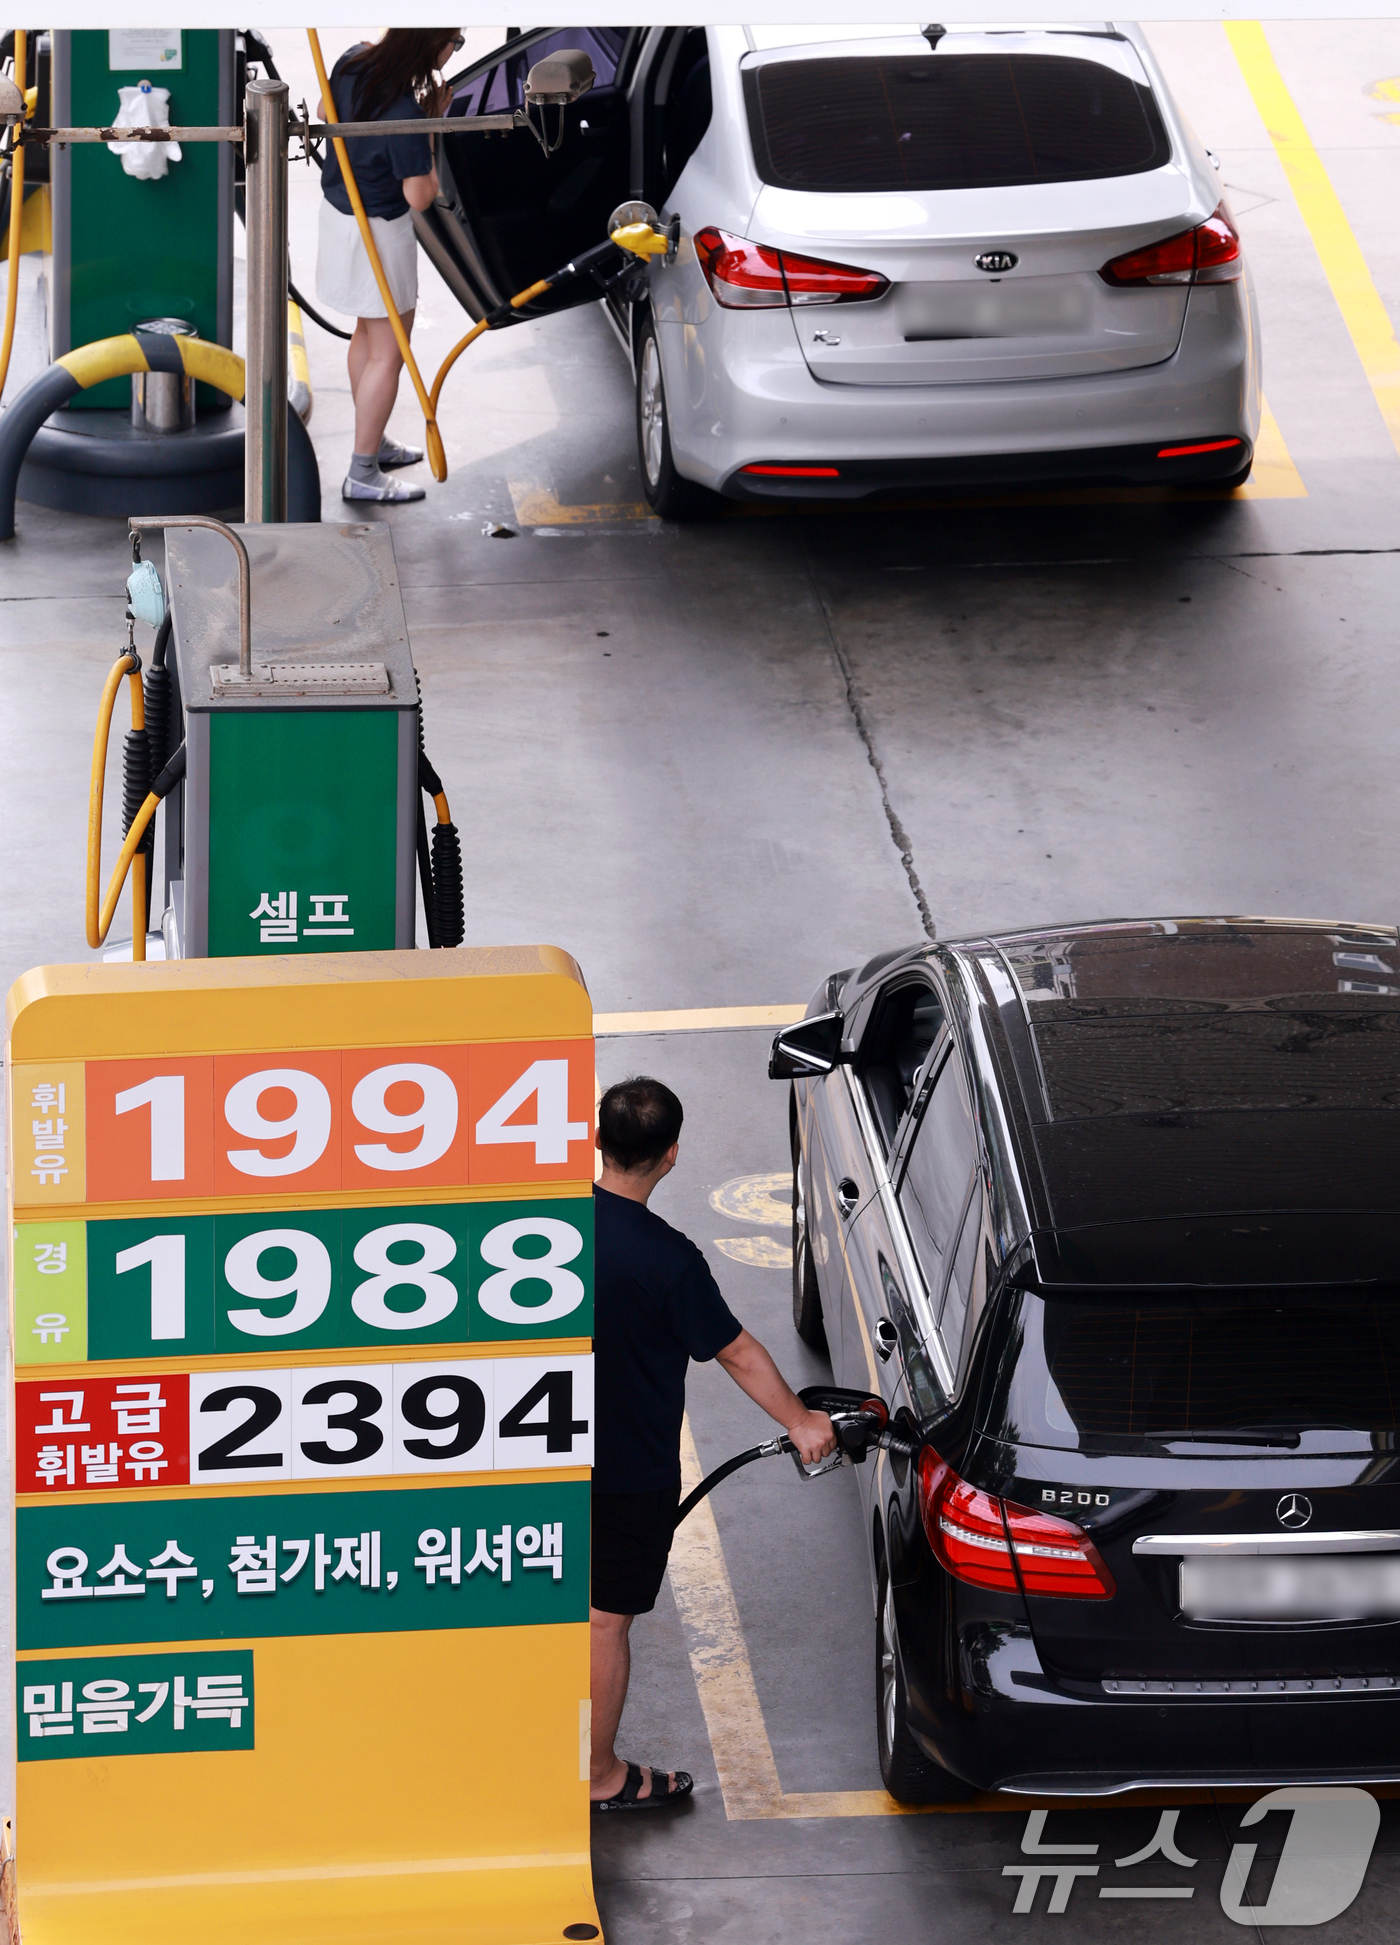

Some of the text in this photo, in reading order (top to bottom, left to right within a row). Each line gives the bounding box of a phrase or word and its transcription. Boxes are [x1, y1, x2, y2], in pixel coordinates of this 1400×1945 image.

[981, 255, 1012, 269] KIA
[248, 890, 355, 943] 셀프
[30, 1082, 69, 1185] 휘발유
[115, 1059, 589, 1181] 1994
[115, 1216, 585, 1340] 1988
[198, 1370, 589, 1471] 2394
[35, 1440, 168, 1486] 휘발유
[1041, 1488, 1110, 1506] B200
[41, 1522, 564, 1600] 요소수, 첨가제, 워셔액
[22, 1674, 249, 1738] 믿음가득
